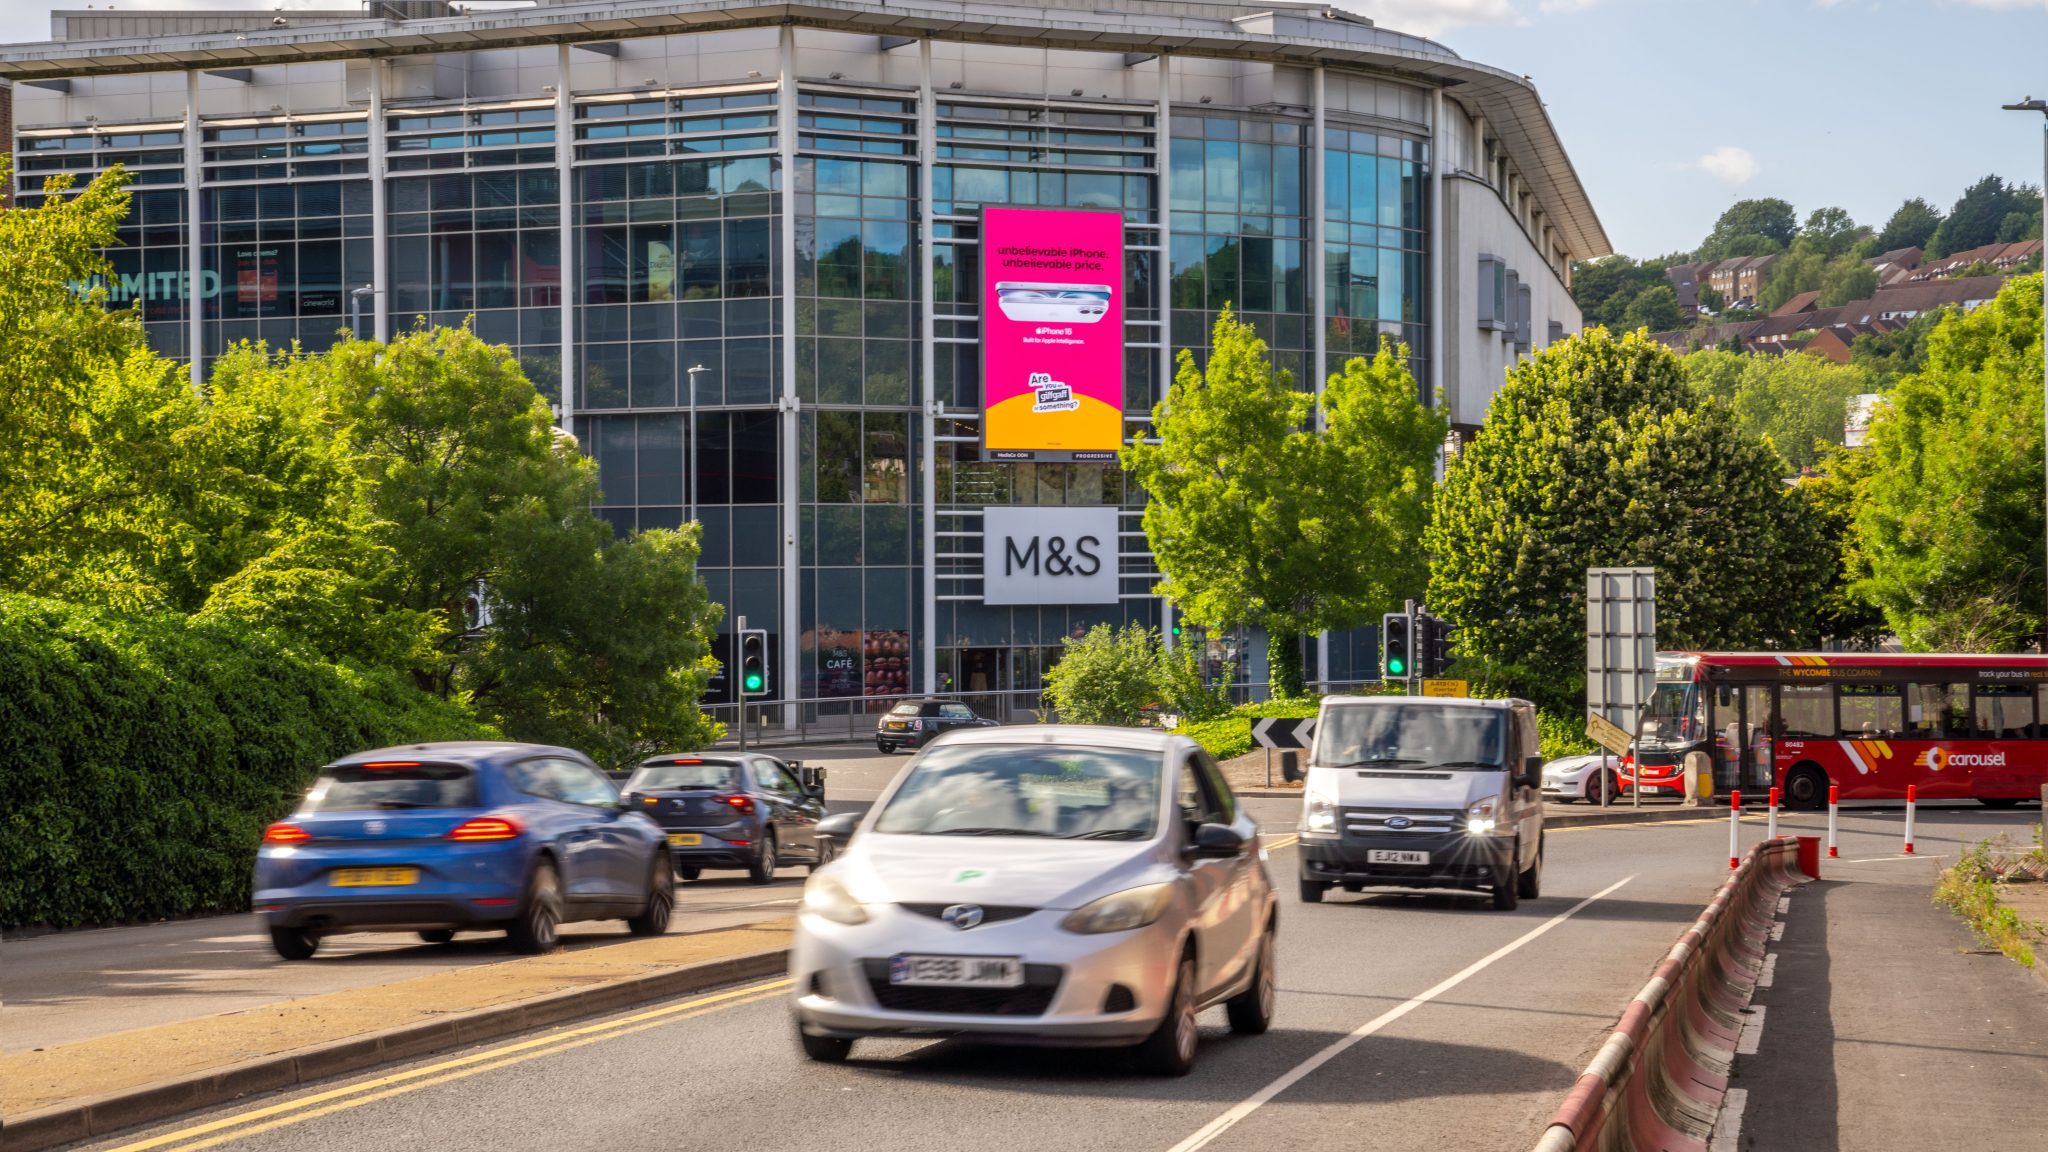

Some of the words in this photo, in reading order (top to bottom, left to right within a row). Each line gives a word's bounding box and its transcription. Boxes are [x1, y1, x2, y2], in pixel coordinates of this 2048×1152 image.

[998, 246, 1067, 257] unbelievable
[1003, 258, 1072, 269] unbelievable
[1075, 260, 1104, 271] price.
[303, 298, 335, 307] cineworld
[1041, 327, 1065, 335] iPhone
[1031, 374, 1049, 384] Are
[1040, 390, 1068, 402] giffgaff
[1040, 400, 1078, 411] something?
[1005, 535, 1101, 576] M&S
[826, 657, 852, 669] CAFÉ
[1793, 669, 1831, 677] WYCOMBE
[1847, 669, 1882, 677] COMPANY
[1996, 671, 2010, 679] your
[2011, 670, 2023, 678] bus
[2024, 670, 2030, 678] in
[1948, 751, 2006, 766] carousel
